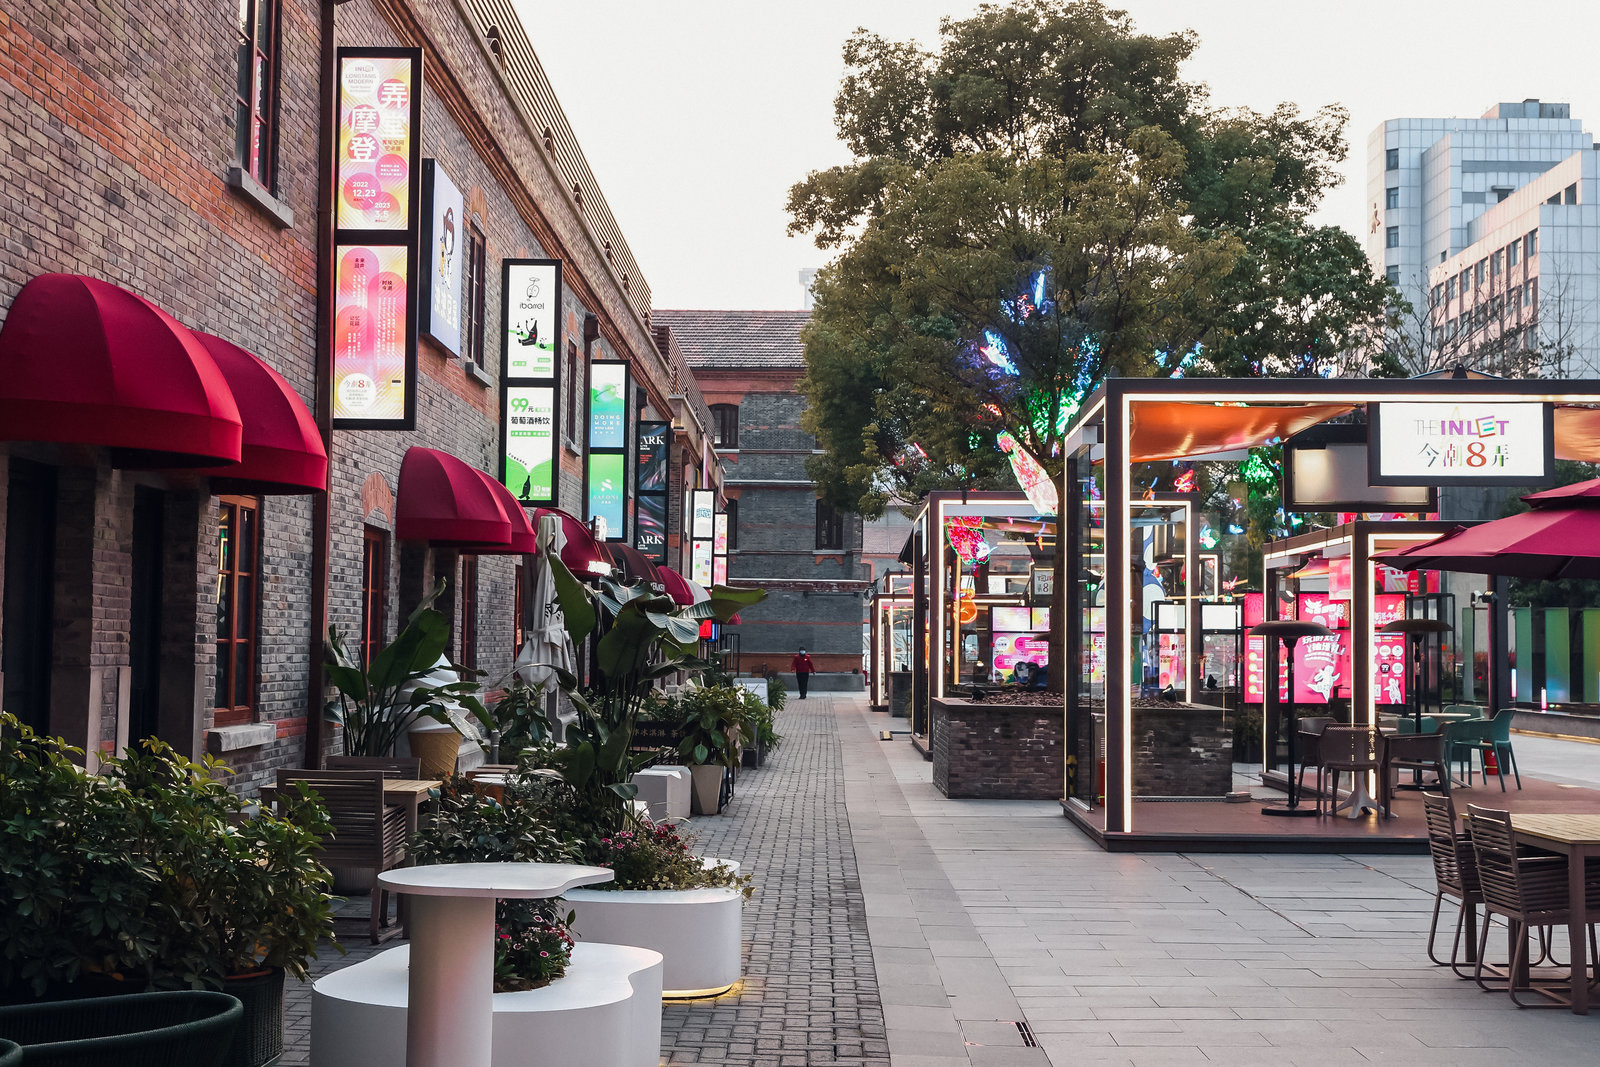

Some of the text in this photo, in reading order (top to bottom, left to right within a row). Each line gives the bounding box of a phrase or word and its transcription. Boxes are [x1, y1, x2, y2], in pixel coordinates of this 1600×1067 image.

[353, 189, 376, 197] 12.23
[511, 416, 551, 425] 葡萄酒畅饮
[1441, 416, 1509, 438] INLET
[640, 435, 665, 445] ARK
[638, 535, 664, 545] ARK
